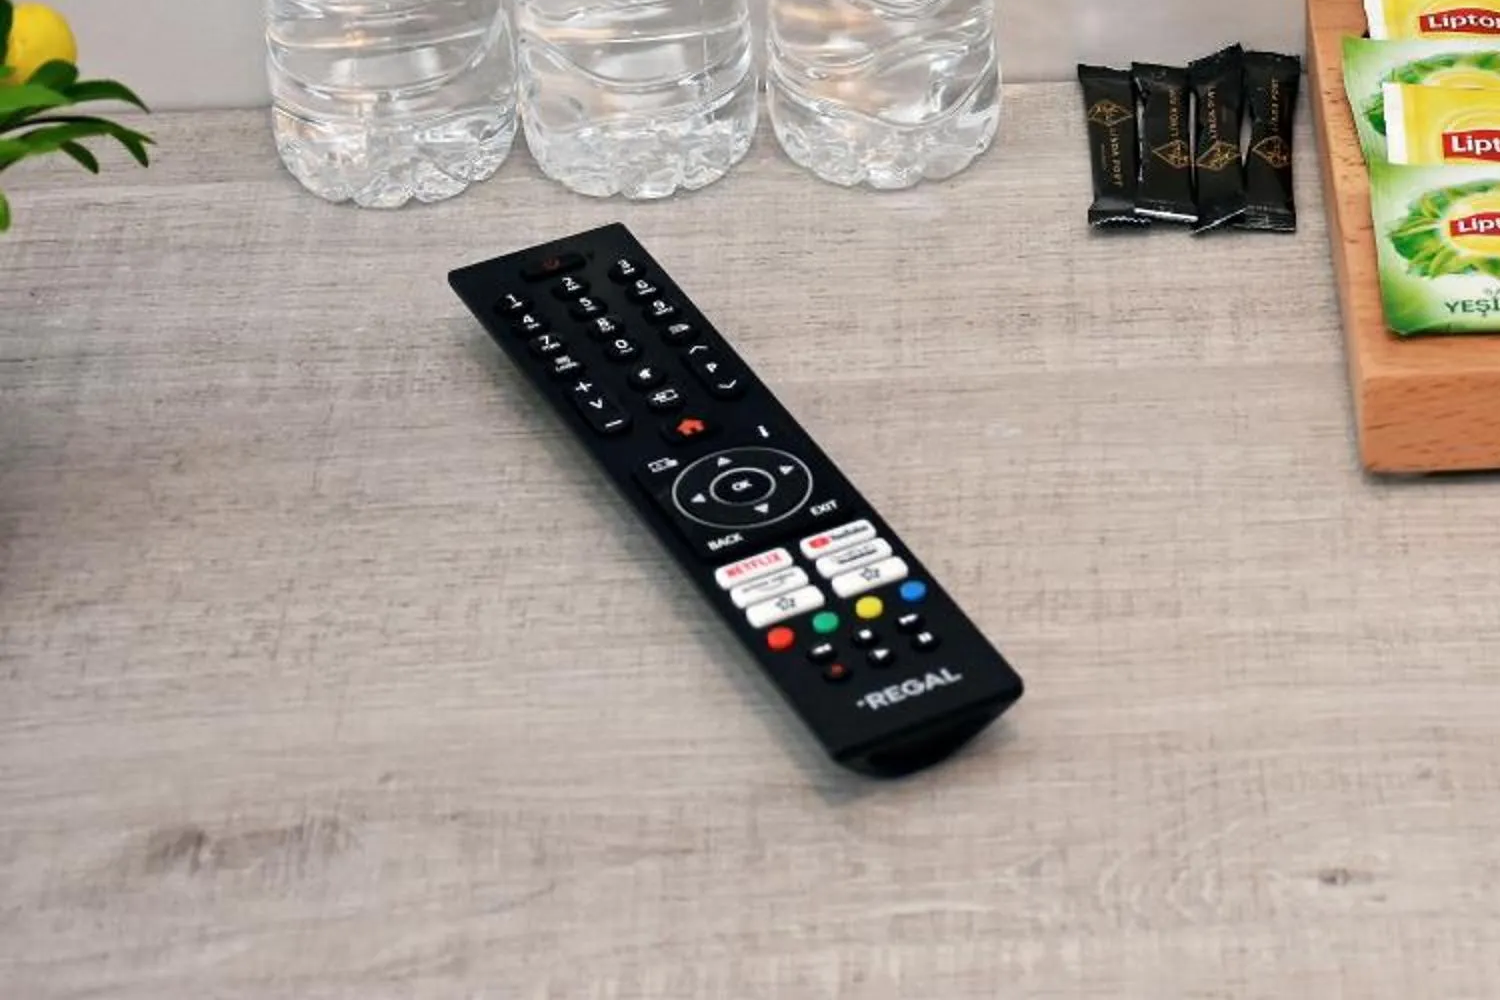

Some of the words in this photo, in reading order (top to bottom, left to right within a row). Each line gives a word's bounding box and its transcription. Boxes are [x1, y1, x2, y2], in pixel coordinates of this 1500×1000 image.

[731, 479, 752, 492] OK
[809, 499, 838, 517] EXIT
[707, 532, 745, 552] BACK
[725, 551, 783, 579] NETFLIX
[864, 667, 963, 710] REGAL
